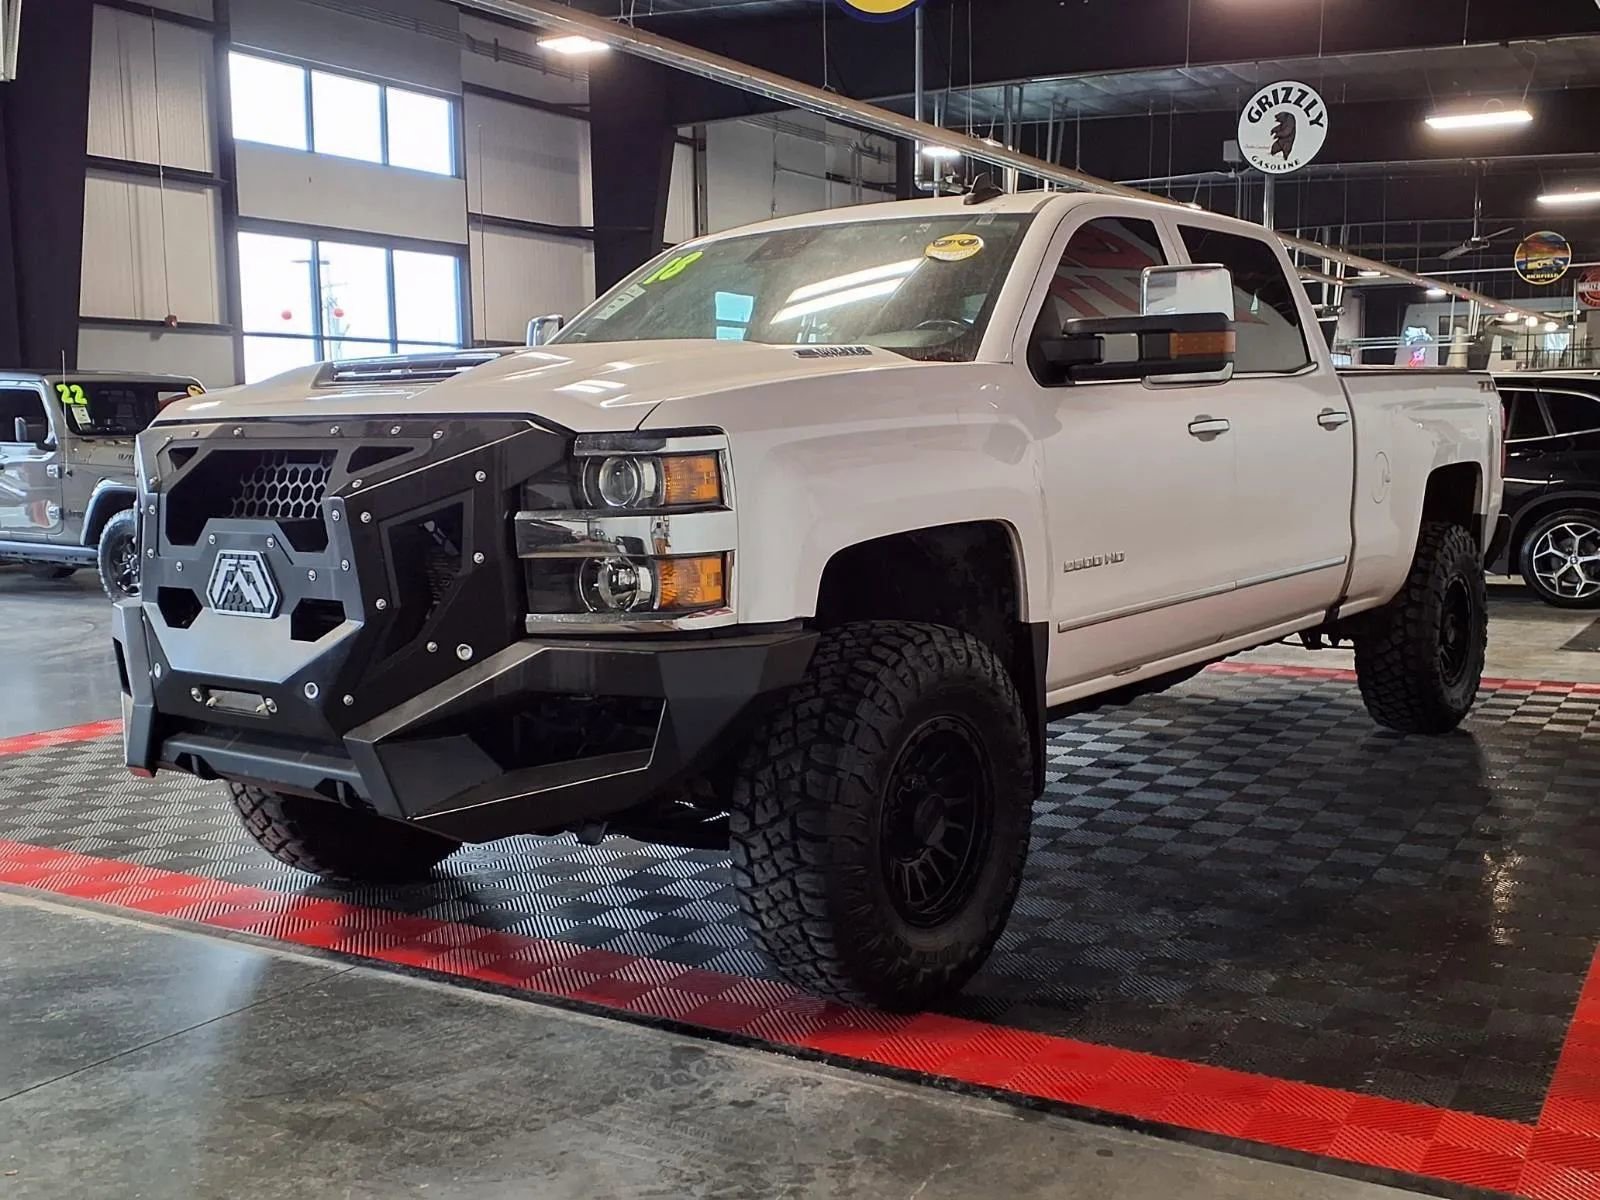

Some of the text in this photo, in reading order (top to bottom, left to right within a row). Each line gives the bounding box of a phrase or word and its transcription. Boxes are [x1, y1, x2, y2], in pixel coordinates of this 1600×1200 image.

[1247, 86, 1324, 128] GRIZZLY
[1251, 155, 1300, 170] GASOLINE
[56, 384, 87, 405] 22
